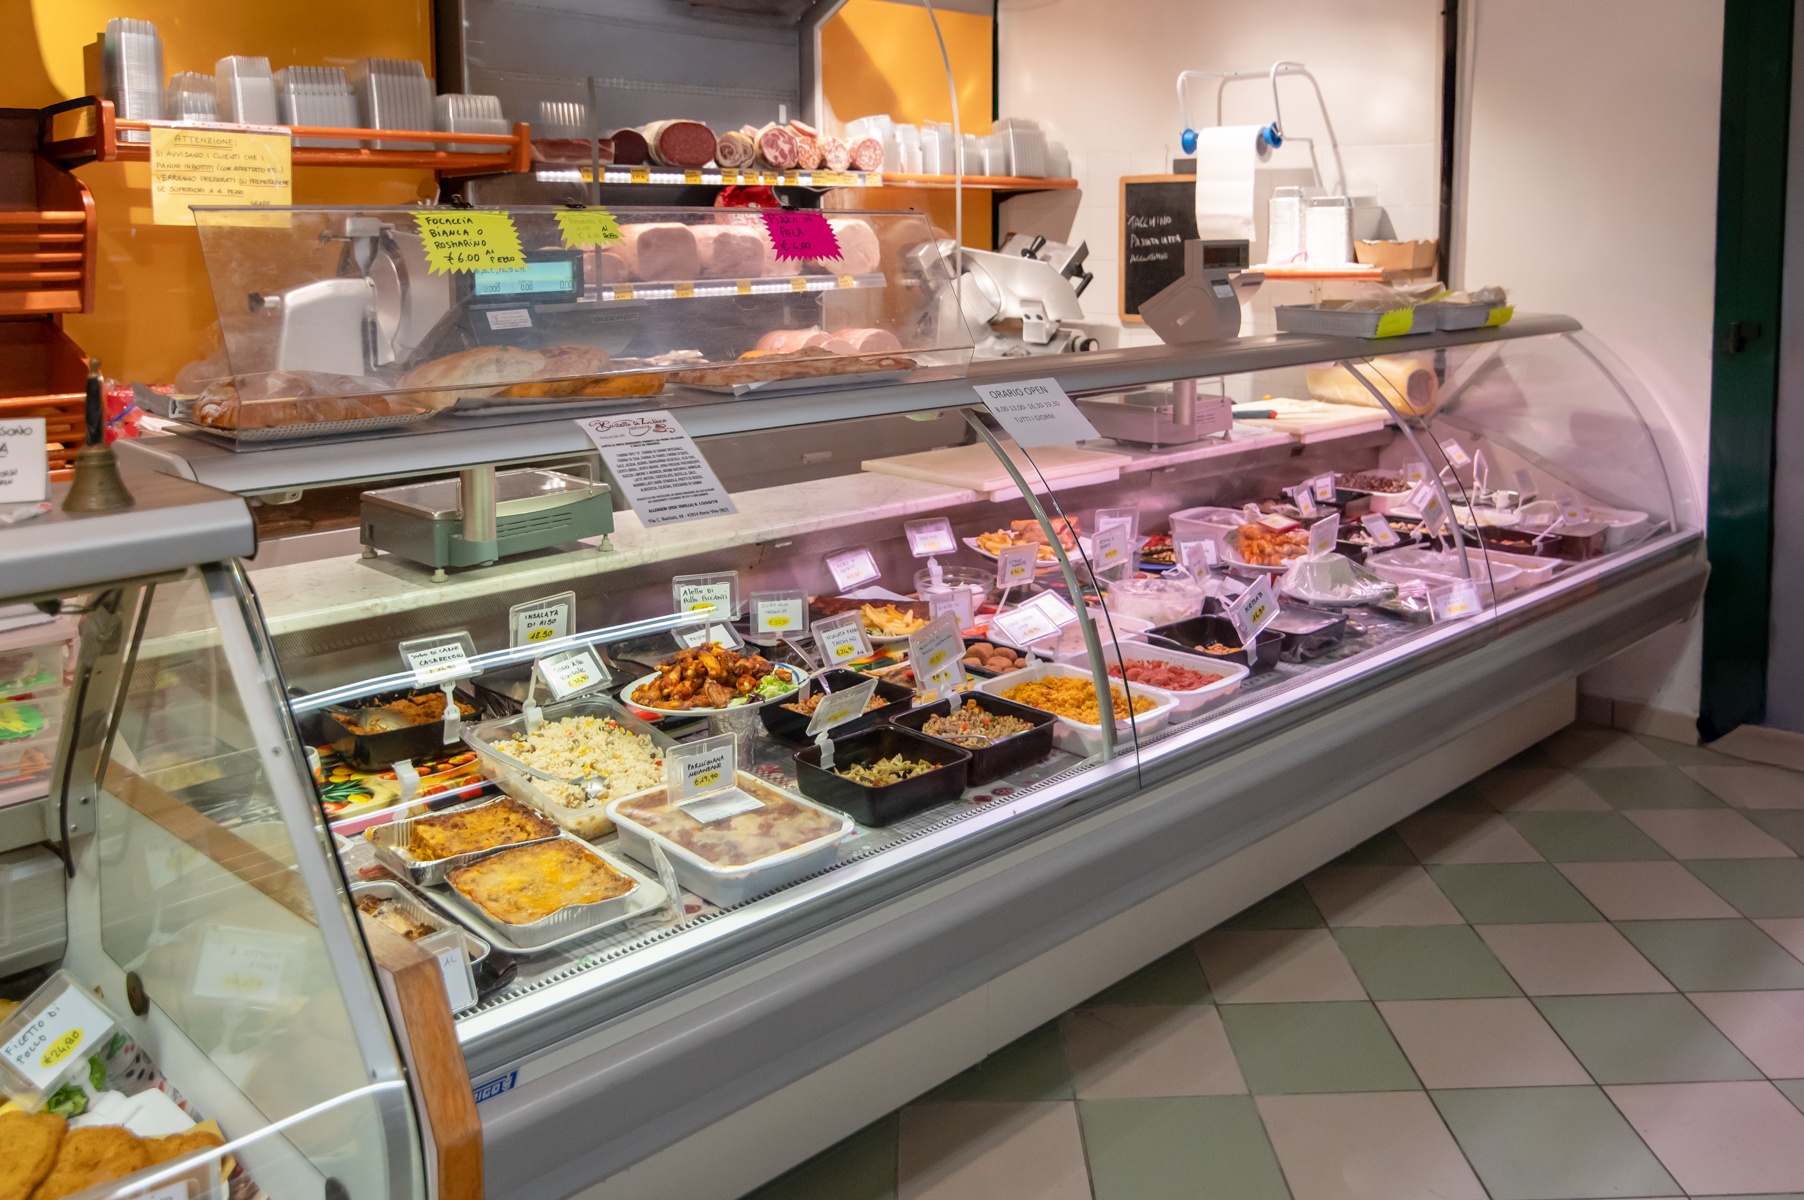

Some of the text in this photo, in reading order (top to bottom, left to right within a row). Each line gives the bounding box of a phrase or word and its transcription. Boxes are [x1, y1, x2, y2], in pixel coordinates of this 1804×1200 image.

[166, 151, 204, 159] AVVISANO
[213, 152, 240, 160] CLIENTI
[156, 174, 196, 182] VERRANNO
[767, 213, 799, 225] PIZZA
[476, 228, 484, 236] O
[780, 226, 805, 237] PALA
[780, 240, 790, 251] €
[988, 385, 1049, 399] ORARIO OPEN
[994, 405, 1010, 413] 8.00
[1013, 415, 1032, 423] TUTTI
[1035, 413, 1056, 421] GIORNI
[1244, 591, 1264, 614] KEBAB
[524, 609, 559, 620] INSALATA
[539, 618, 557, 626] RISO
[4, 1003, 61, 1056] FILETTO DI
[16, 1034, 47, 1065] POLLO
